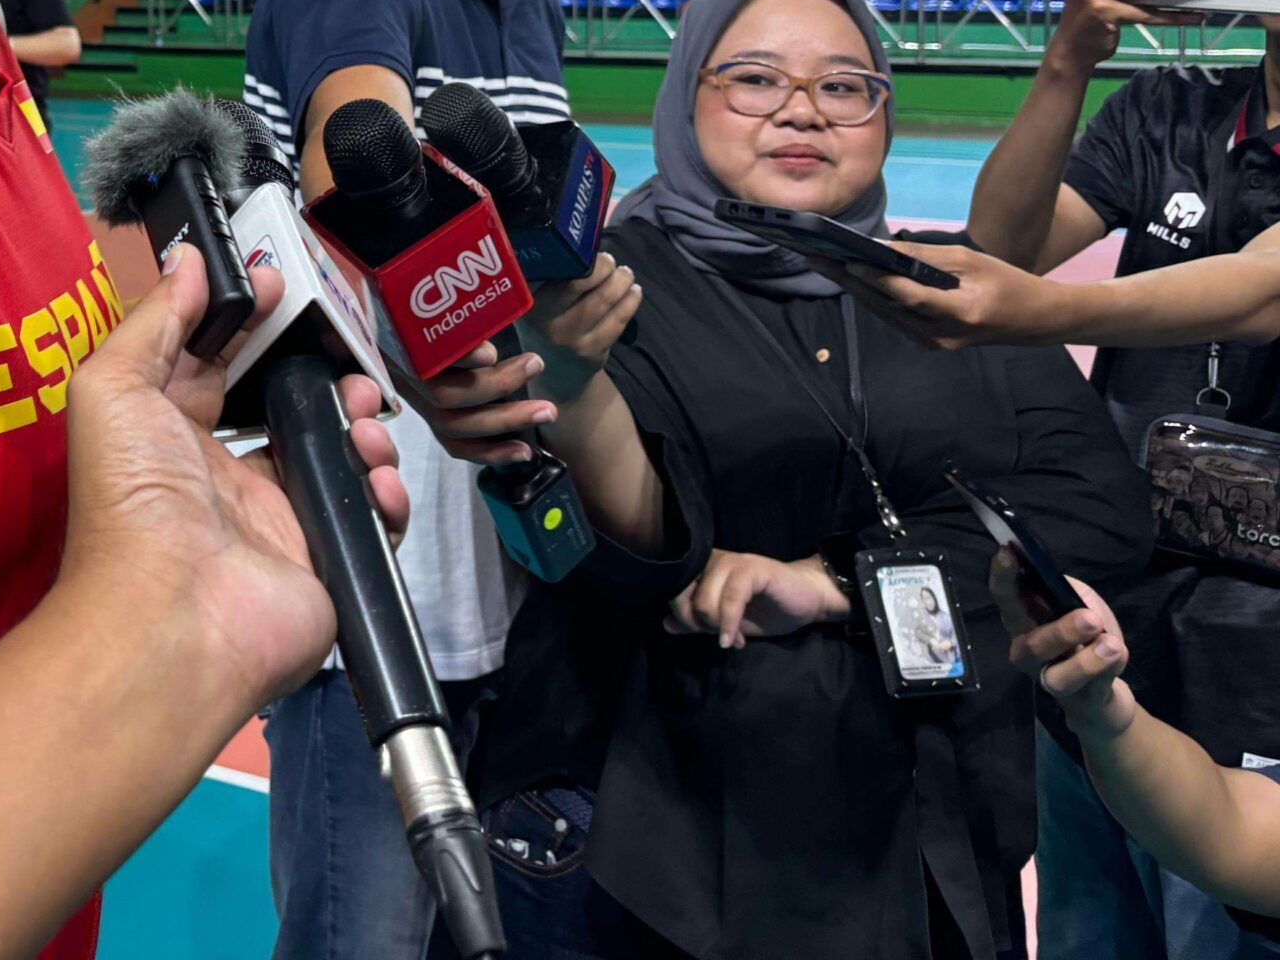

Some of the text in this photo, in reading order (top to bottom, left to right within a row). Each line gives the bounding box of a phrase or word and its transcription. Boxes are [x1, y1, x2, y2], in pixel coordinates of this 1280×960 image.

[568, 164, 595, 243] KOMPAS
[1146, 221, 1192, 250] MILLS
[160, 222, 190, 262] SONY
[409, 234, 503, 319] CNN
[422, 277, 513, 344] Indonesia
